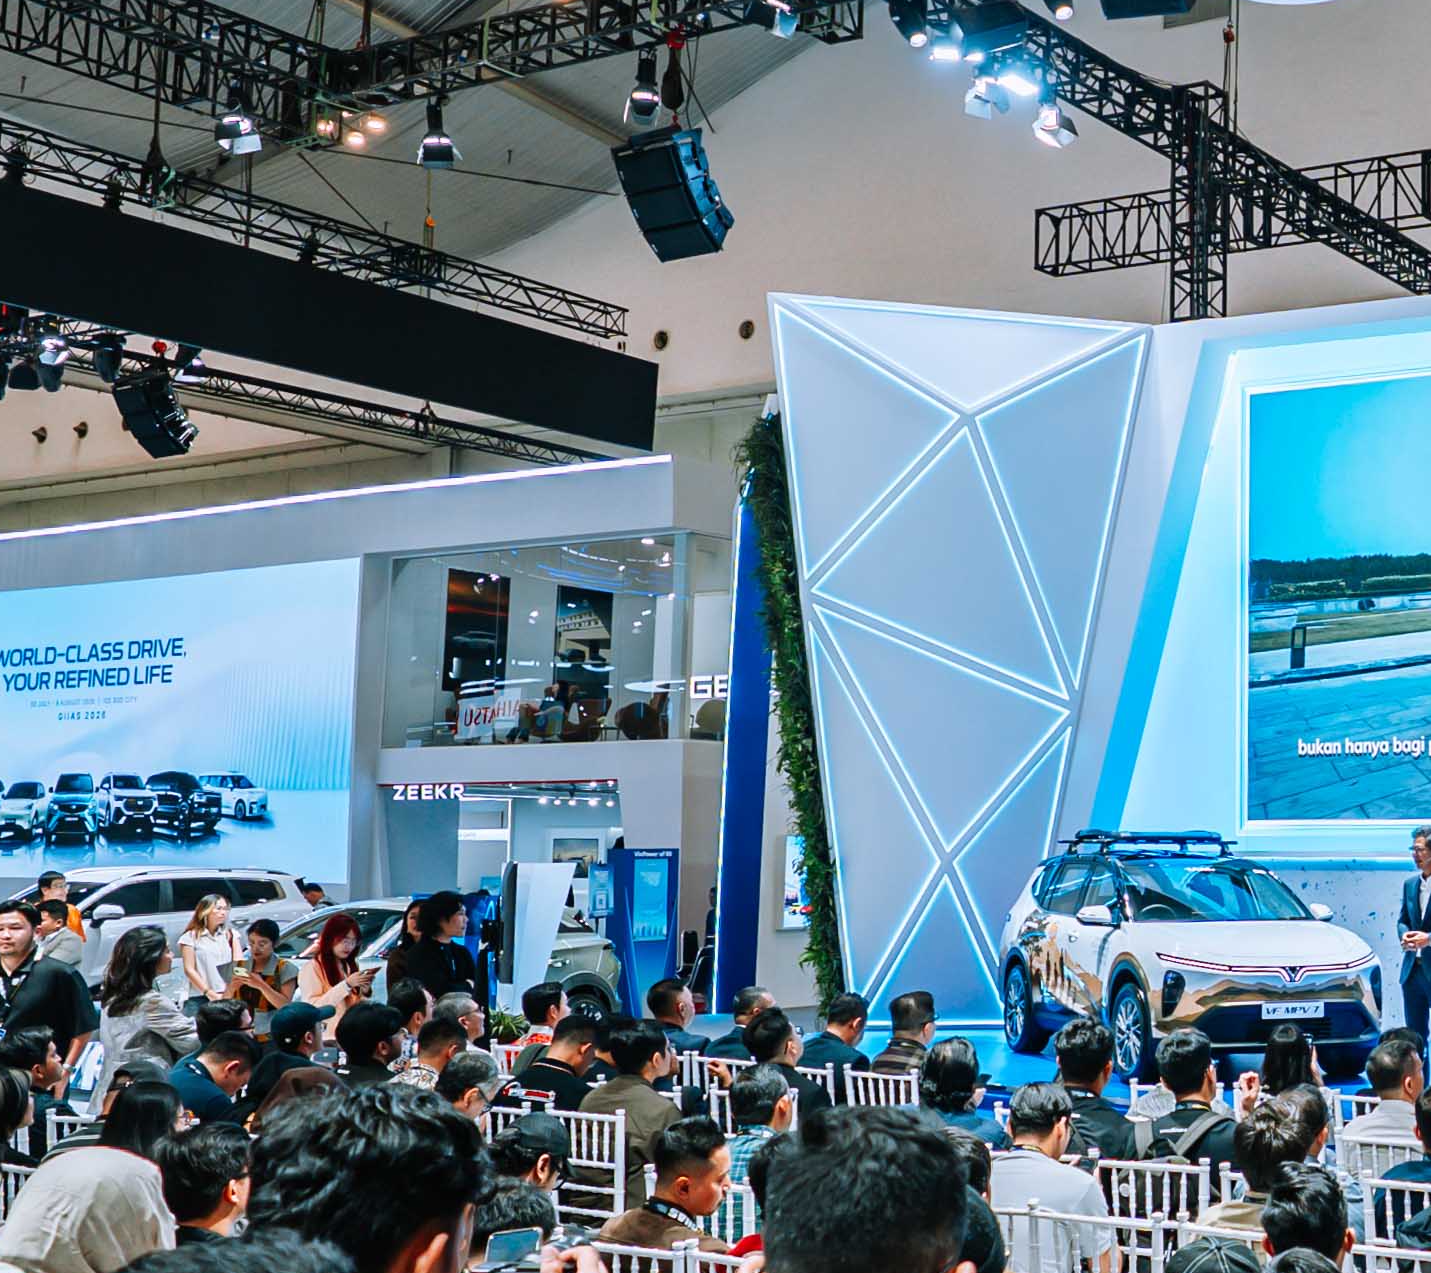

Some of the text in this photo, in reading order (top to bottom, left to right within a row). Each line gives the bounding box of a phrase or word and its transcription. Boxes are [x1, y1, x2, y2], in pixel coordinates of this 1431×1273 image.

[127, 637, 187, 660] DRIVE,
[3, 664, 174, 692] YOUR REFINED LIFE
[1297, 738, 1342, 756] bukan
[1345, 737, 1389, 759] hanya
[1392, 735, 1425, 758] bagi
[392, 783, 465, 801] ZEEKR
[1312, 1005, 1320, 1014] 7
